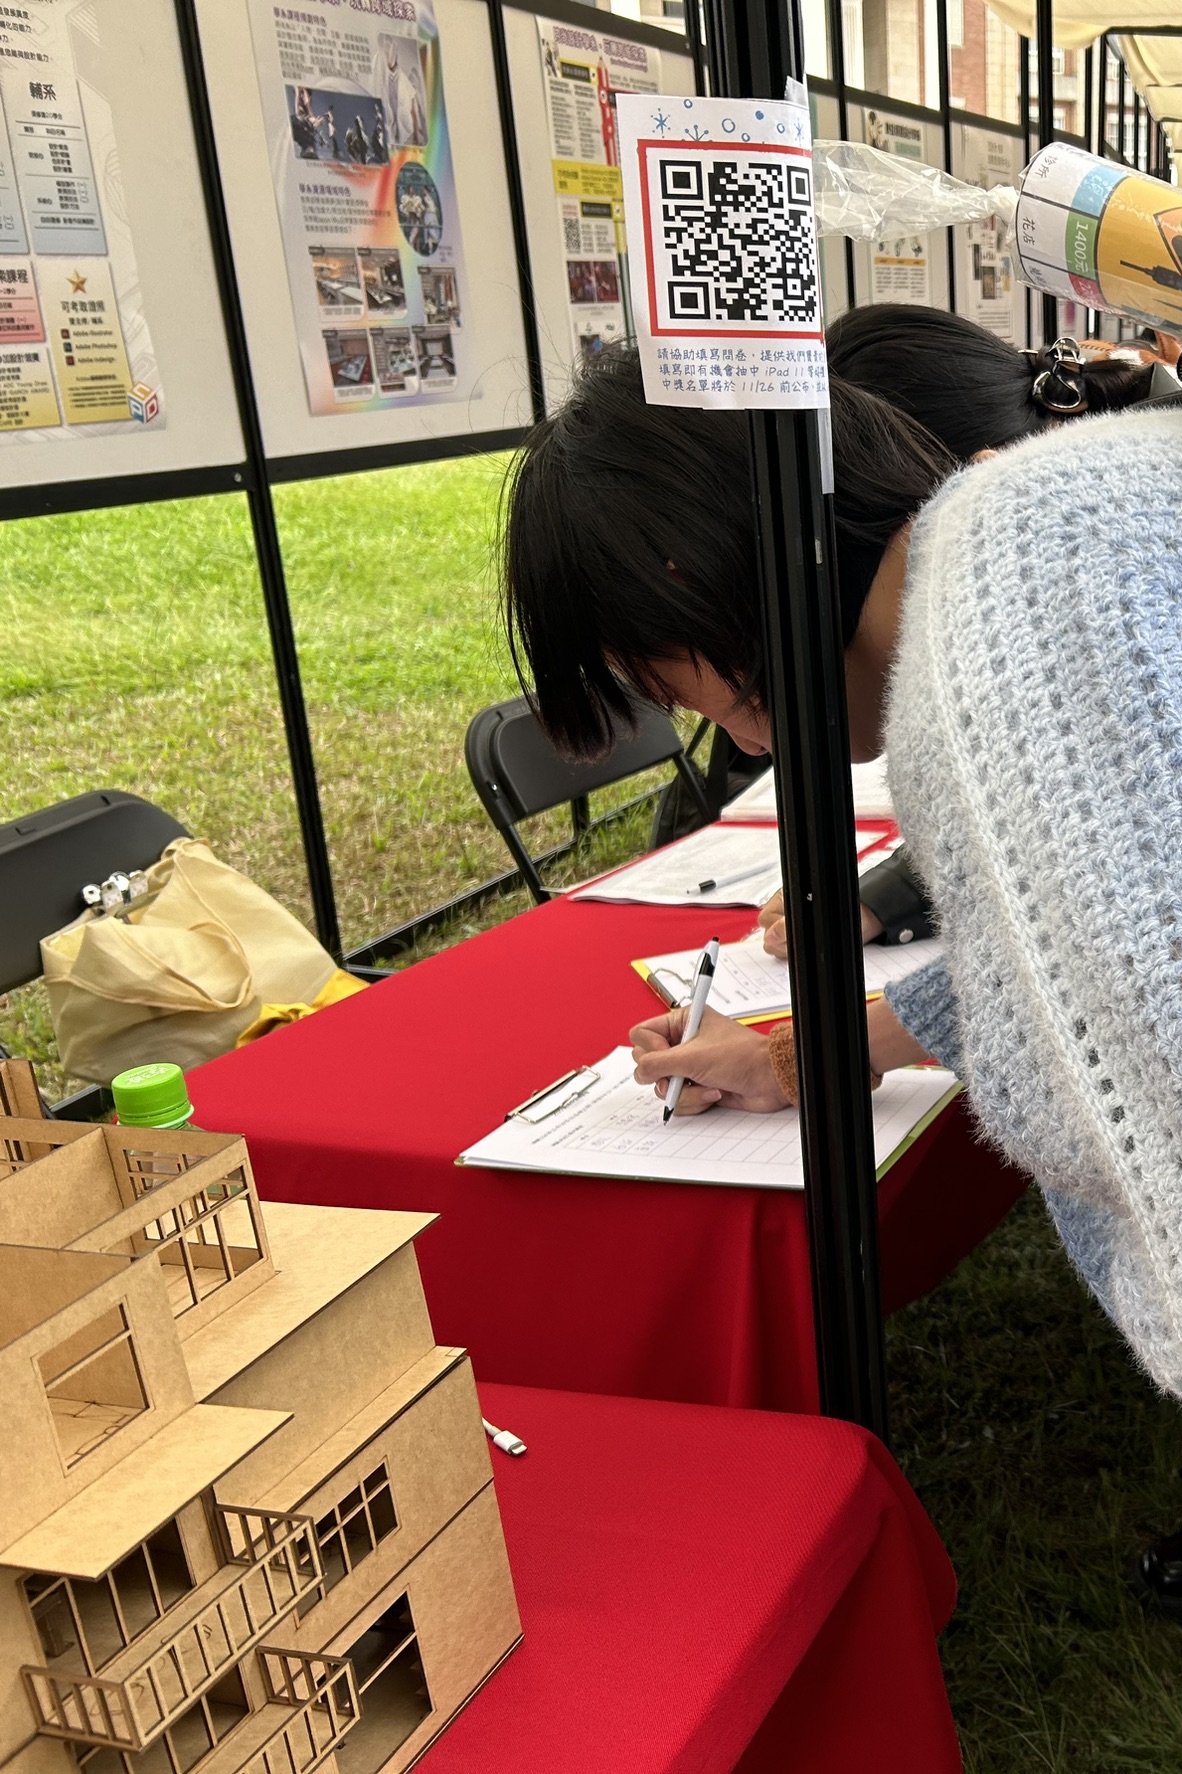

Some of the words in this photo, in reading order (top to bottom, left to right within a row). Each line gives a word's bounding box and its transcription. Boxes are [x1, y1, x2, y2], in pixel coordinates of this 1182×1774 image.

[1022, 216, 1036, 246] 花店
[1073, 220, 1089, 273] 1400元
[659, 364, 760, 377] 填寫即有機會抽中
[765, 366, 789, 377] iPad
[662, 379, 736, 393] 中獎名單將於
[741, 380, 774, 393] 11/26
